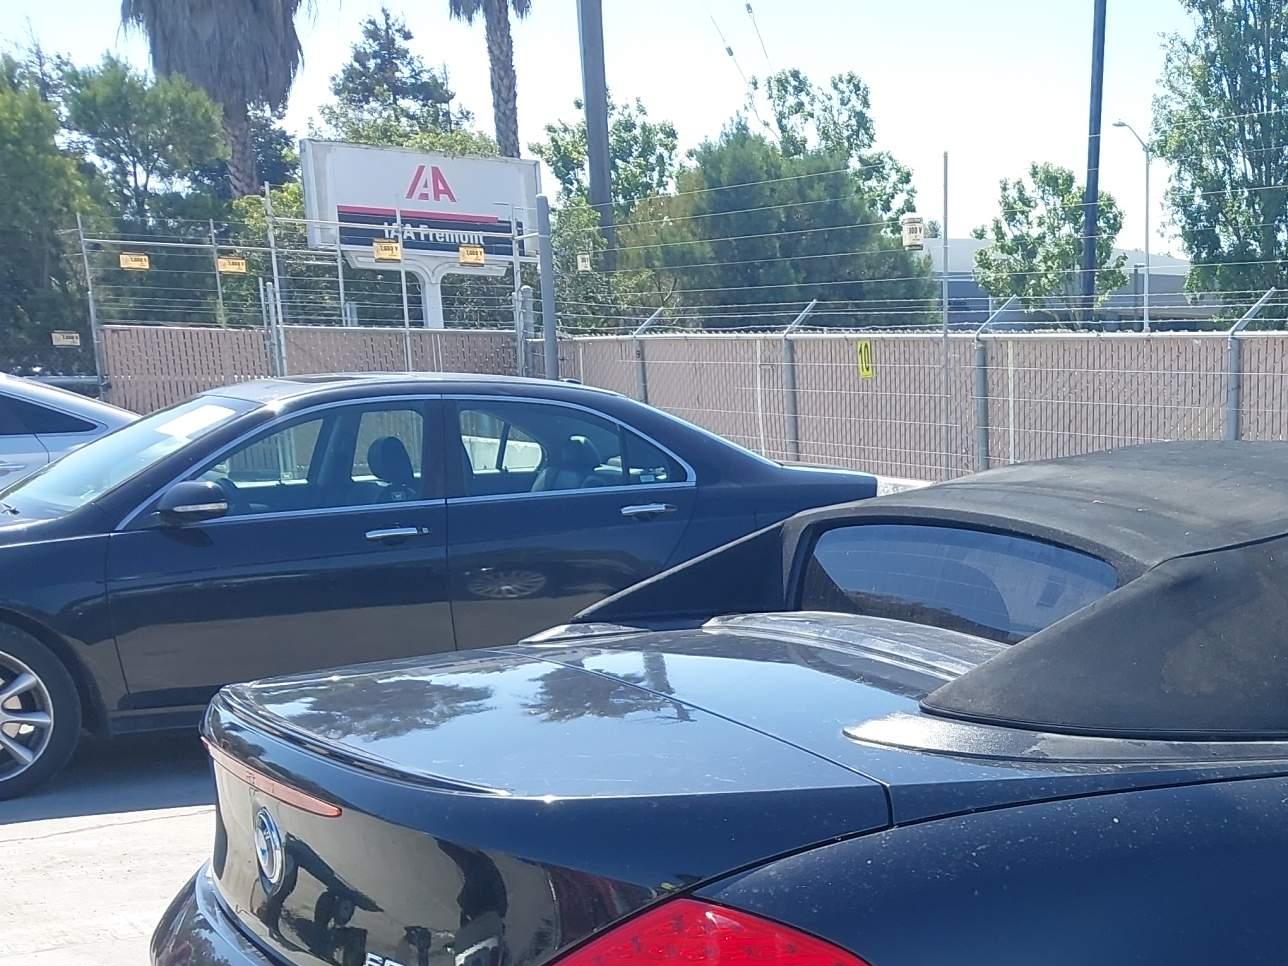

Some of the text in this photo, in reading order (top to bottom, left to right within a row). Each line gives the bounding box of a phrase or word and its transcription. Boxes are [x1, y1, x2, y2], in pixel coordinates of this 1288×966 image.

[383, 222, 485, 245] IAA Fremont
[859, 342, 870, 372] 10
